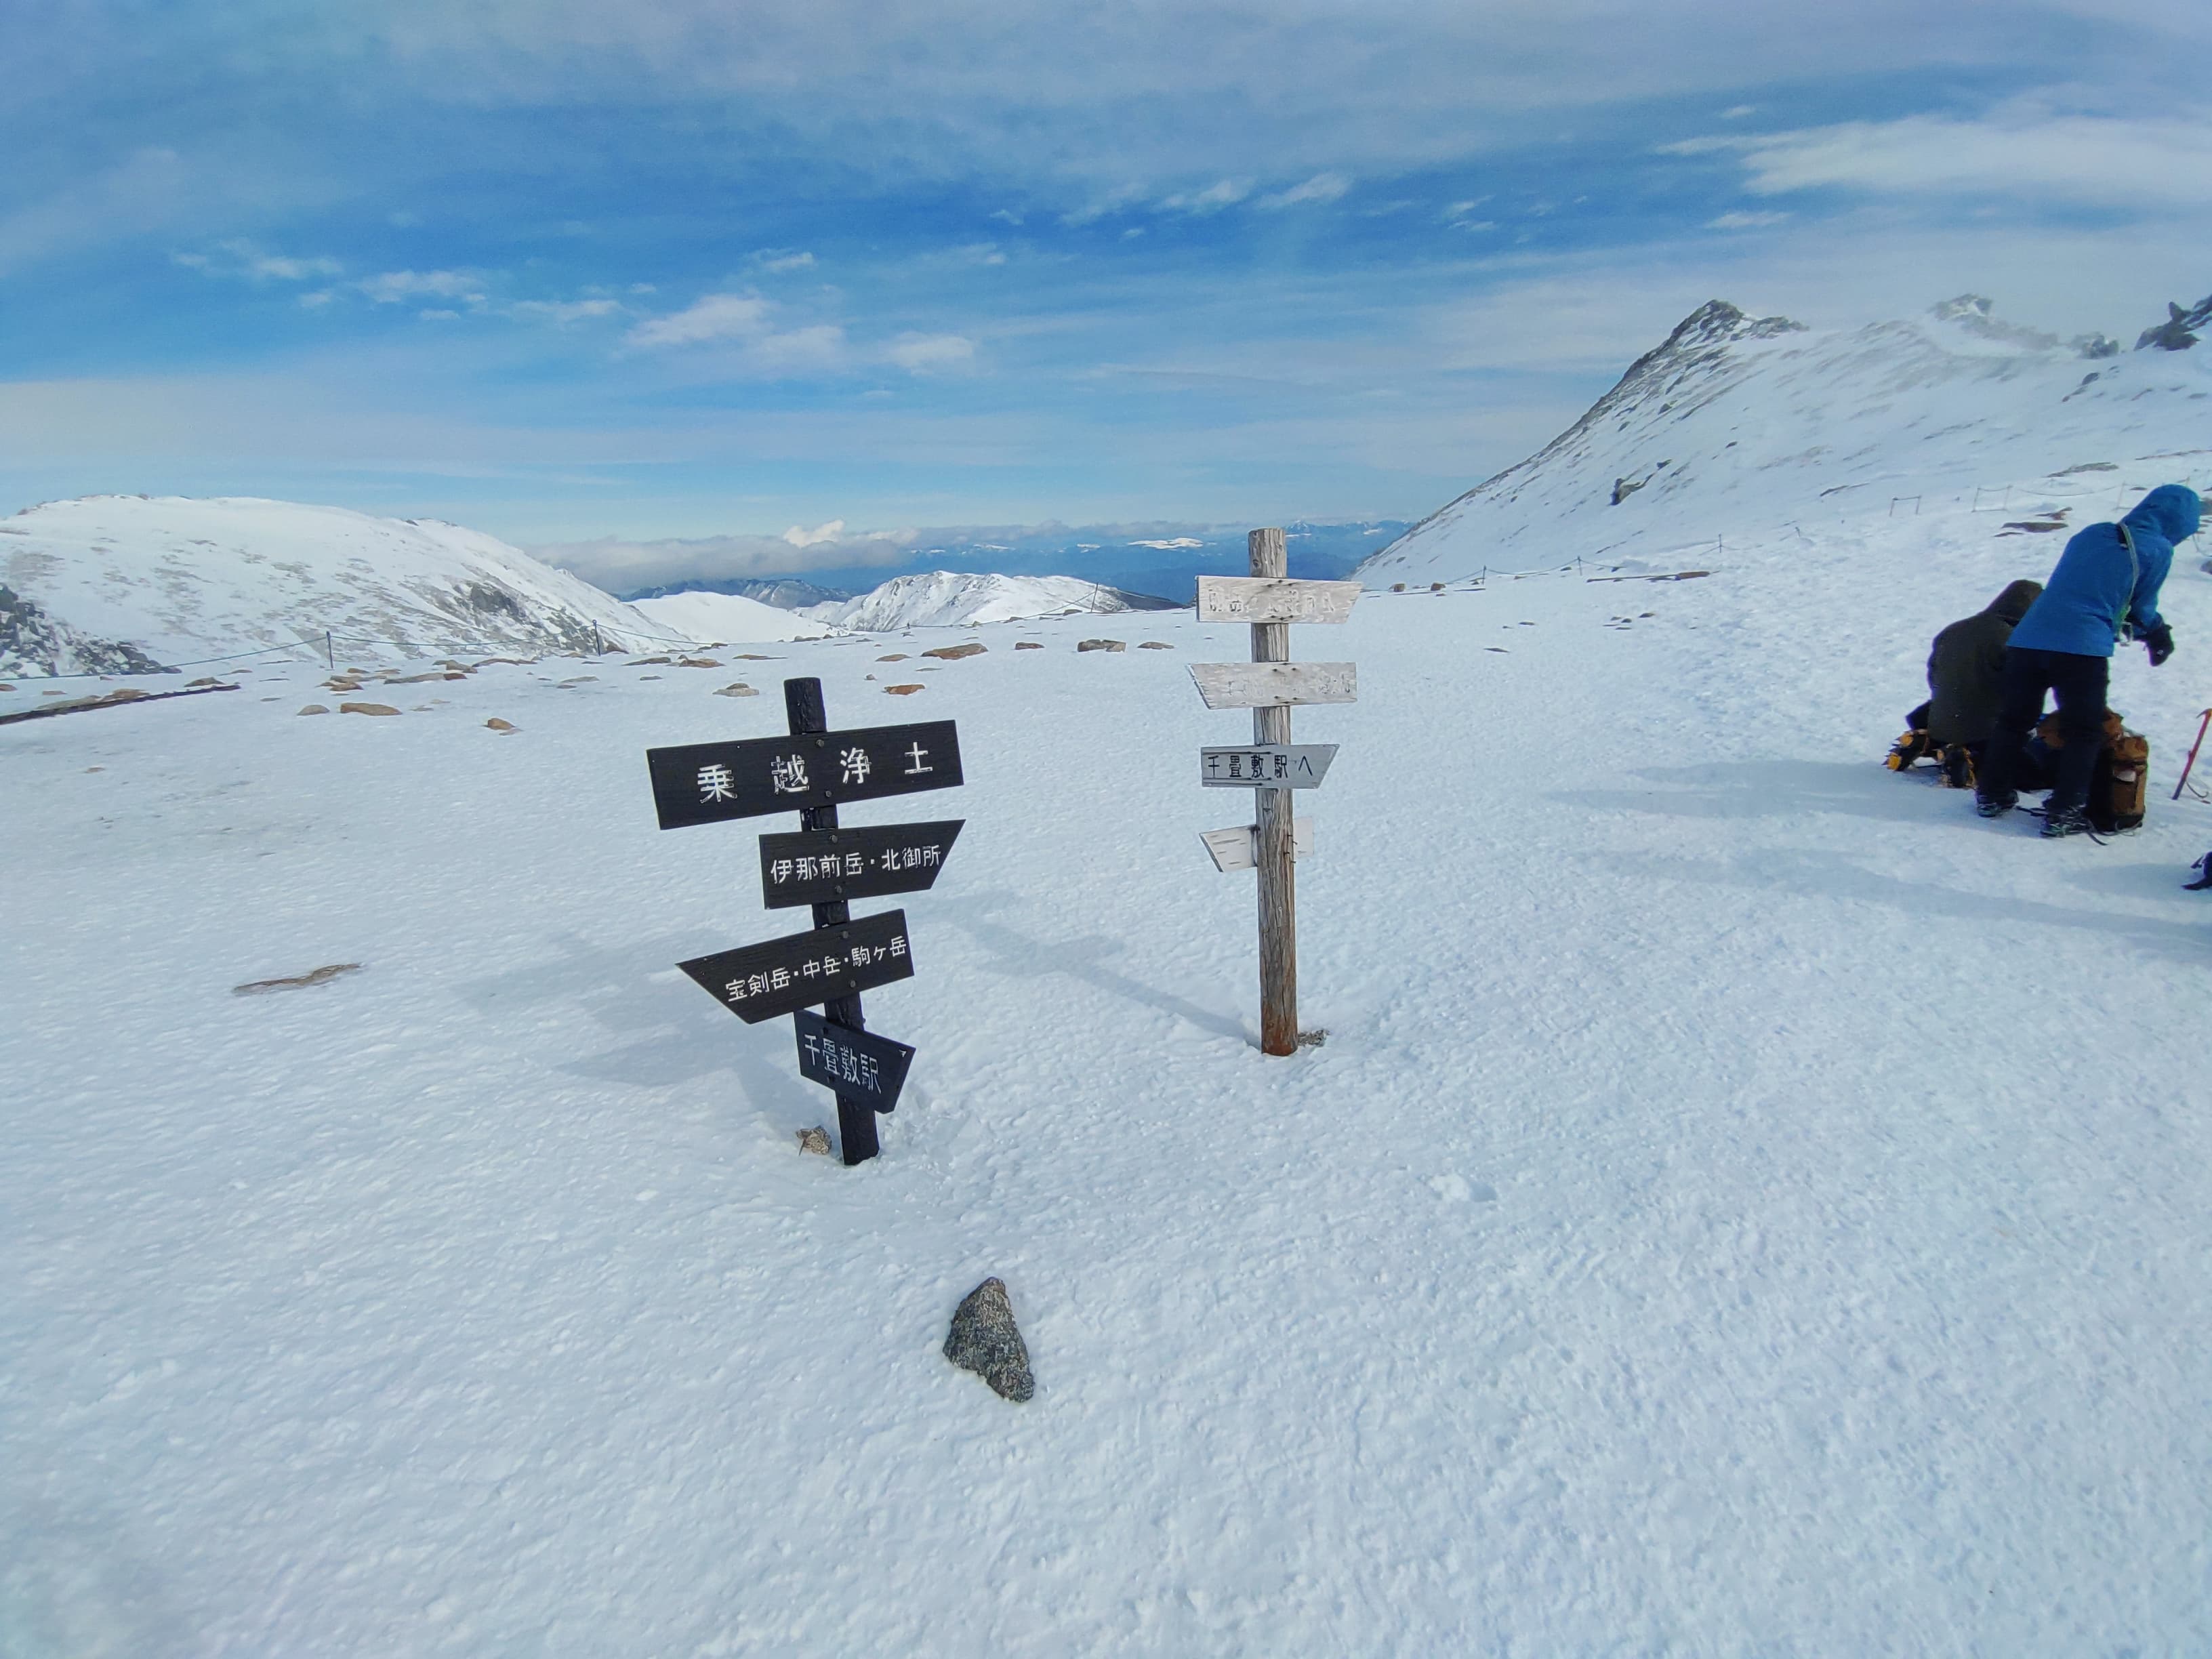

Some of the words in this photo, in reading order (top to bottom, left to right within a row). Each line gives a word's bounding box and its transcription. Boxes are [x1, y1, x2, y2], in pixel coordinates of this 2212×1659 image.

[697, 741, 933, 804] 乗越浄土
[1208, 755, 1313, 779] 千畳敷駅へ
[771, 844, 941, 884] 伊那前岳・北御所
[804, 1034, 882, 1094] 千畳敷駅
